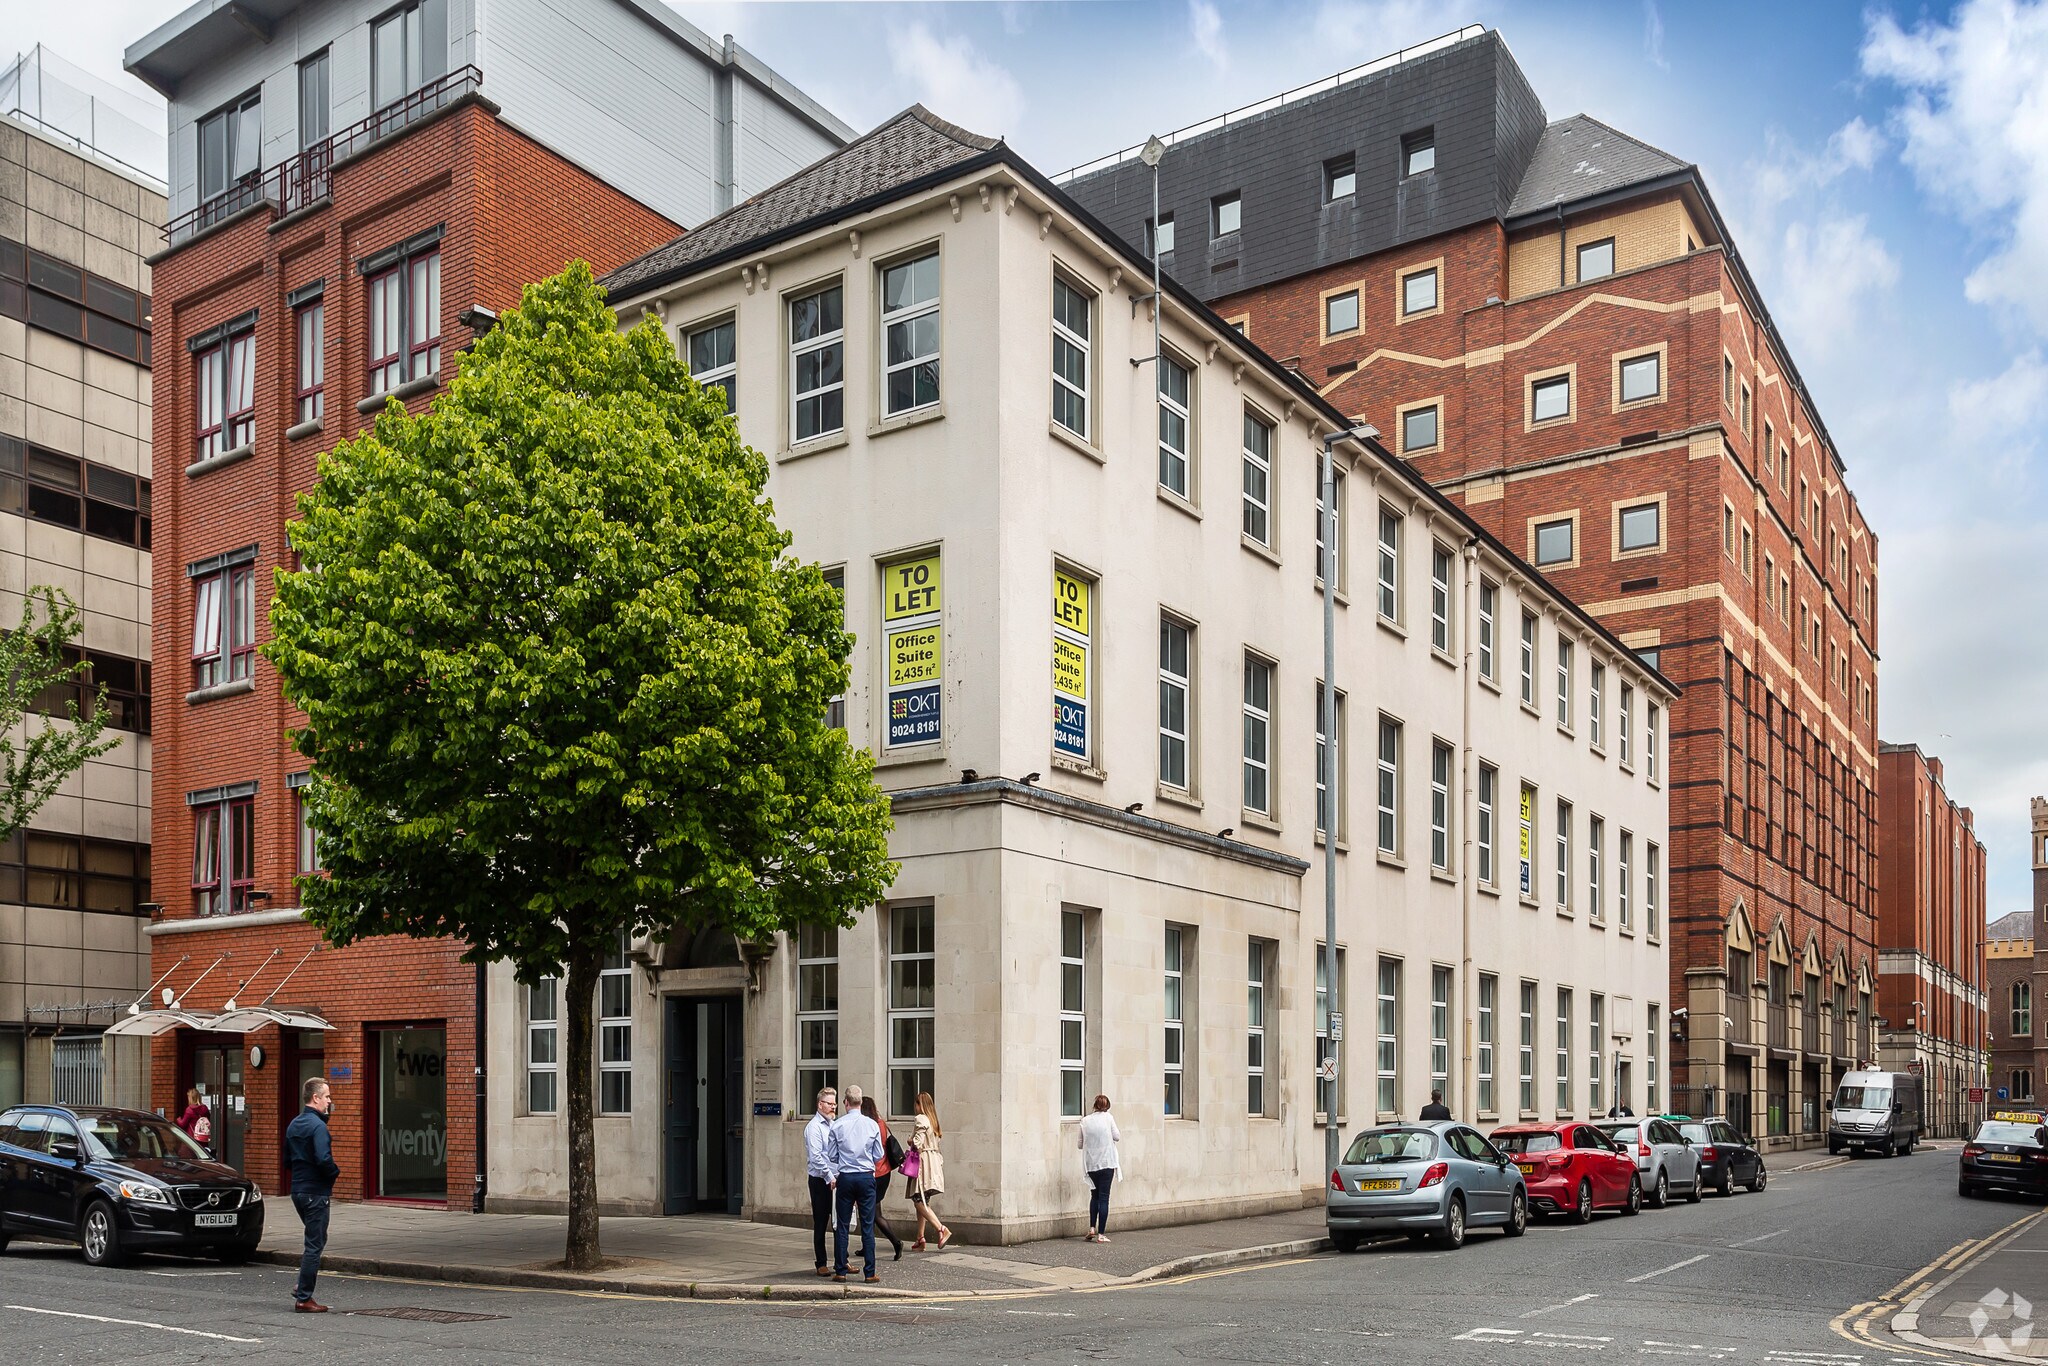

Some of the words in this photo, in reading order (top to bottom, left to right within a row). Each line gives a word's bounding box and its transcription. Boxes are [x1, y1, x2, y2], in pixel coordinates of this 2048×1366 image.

[899, 565, 929, 588] TO
[1056, 575, 1078, 602] TO
[895, 586, 936, 612] LET
[1054, 597, 1083, 626] LET
[895, 634, 936, 649] Office
[896, 650, 934, 665] Suite
[1054, 657, 1080, 677] Suite
[894, 665, 924, 683] 2,435
[908, 692, 940, 713] OKT
[1061, 705, 1084, 727] OKT
[892, 723, 915, 738] 9024
[917, 719, 940, 734] 8181
[1054, 728, 1067, 743] 024
[1067, 733, 1084, 749] 8181
[1520, 790, 1527, 803] O
[1520, 803, 1528, 817] ET
[1363, 1181, 1378, 1190] FFZ
[1378, 1180, 1397, 1189] 5855
[200, 1215, 217, 1224] NY61
[218, 1215, 233, 1224] LXB
